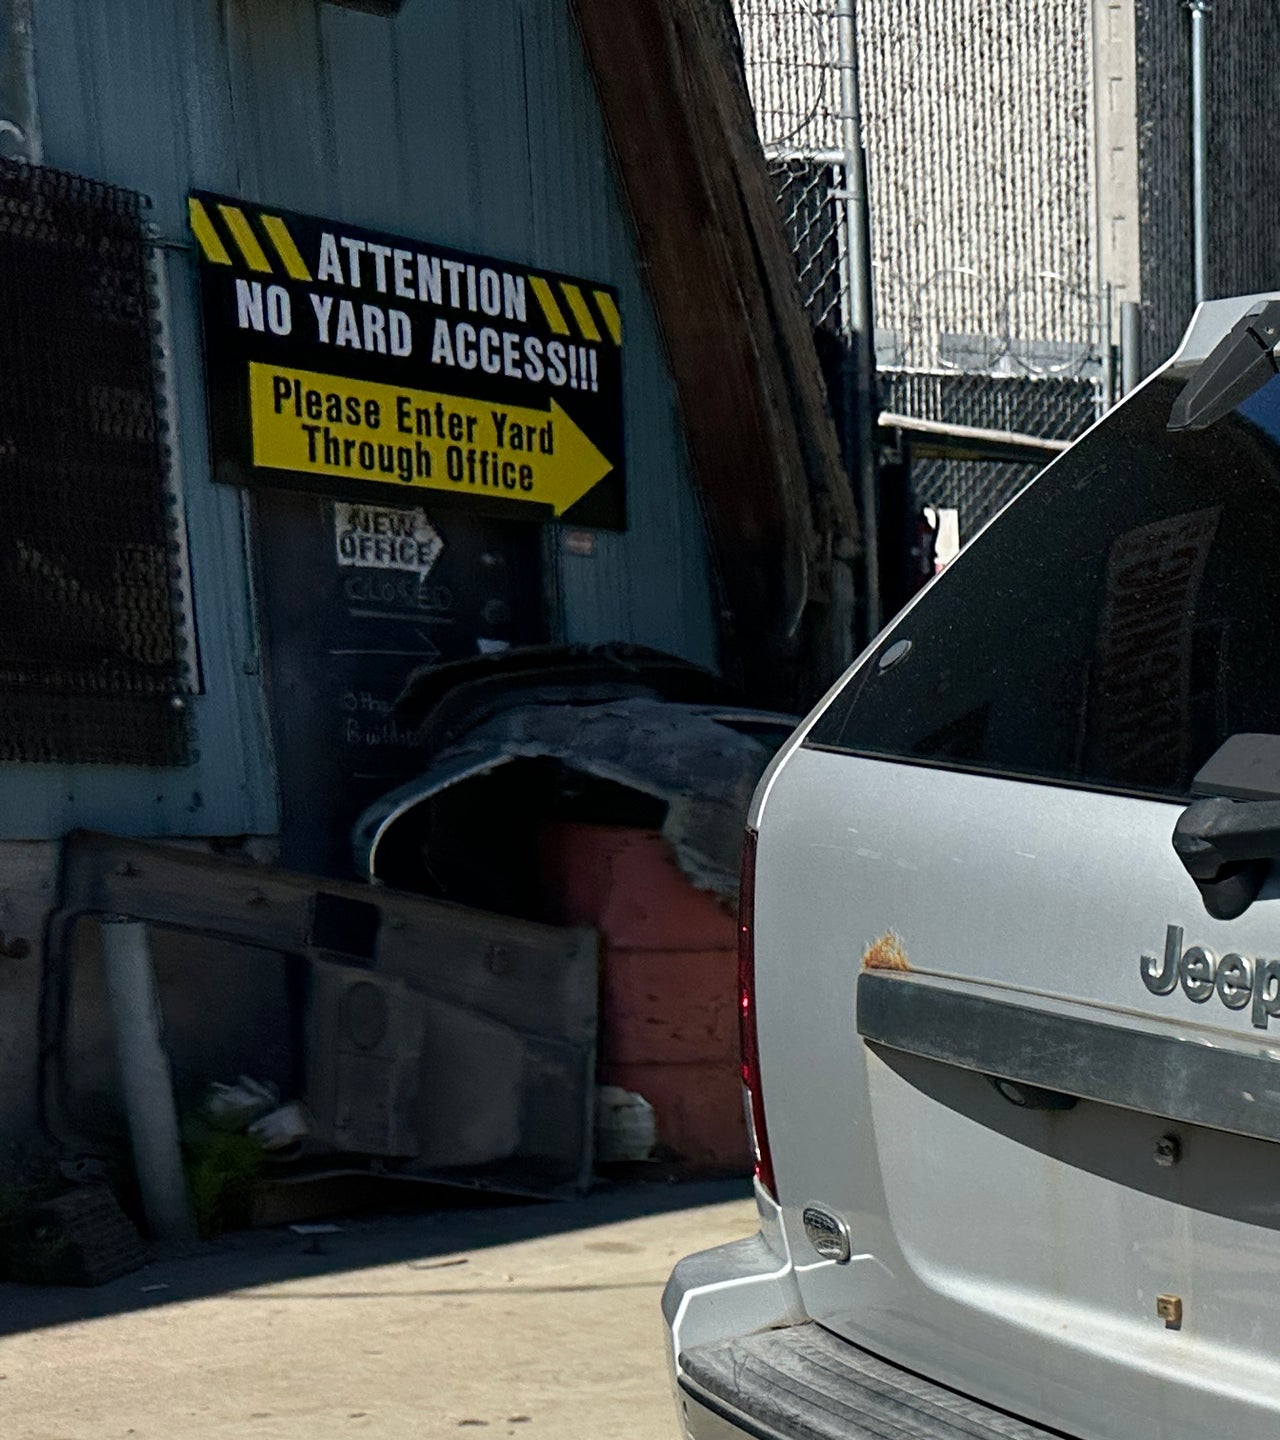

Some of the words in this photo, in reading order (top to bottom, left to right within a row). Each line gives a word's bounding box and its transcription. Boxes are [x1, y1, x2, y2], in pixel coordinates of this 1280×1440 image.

[316, 231, 528, 323] ATTENTION
[235, 278, 292, 337] NO
[308, 293, 413, 358] YARD
[430, 317, 599, 393] ACCESS!!!
[272, 375, 382, 429] Please
[395, 396, 479, 444] Enter
[490, 411, 555, 456] Yard
[300, 425, 432, 483] Through
[446, 444, 534, 492] Office
[340, 530, 432, 566] OFFICE
[348, 507, 417, 537] NEW
